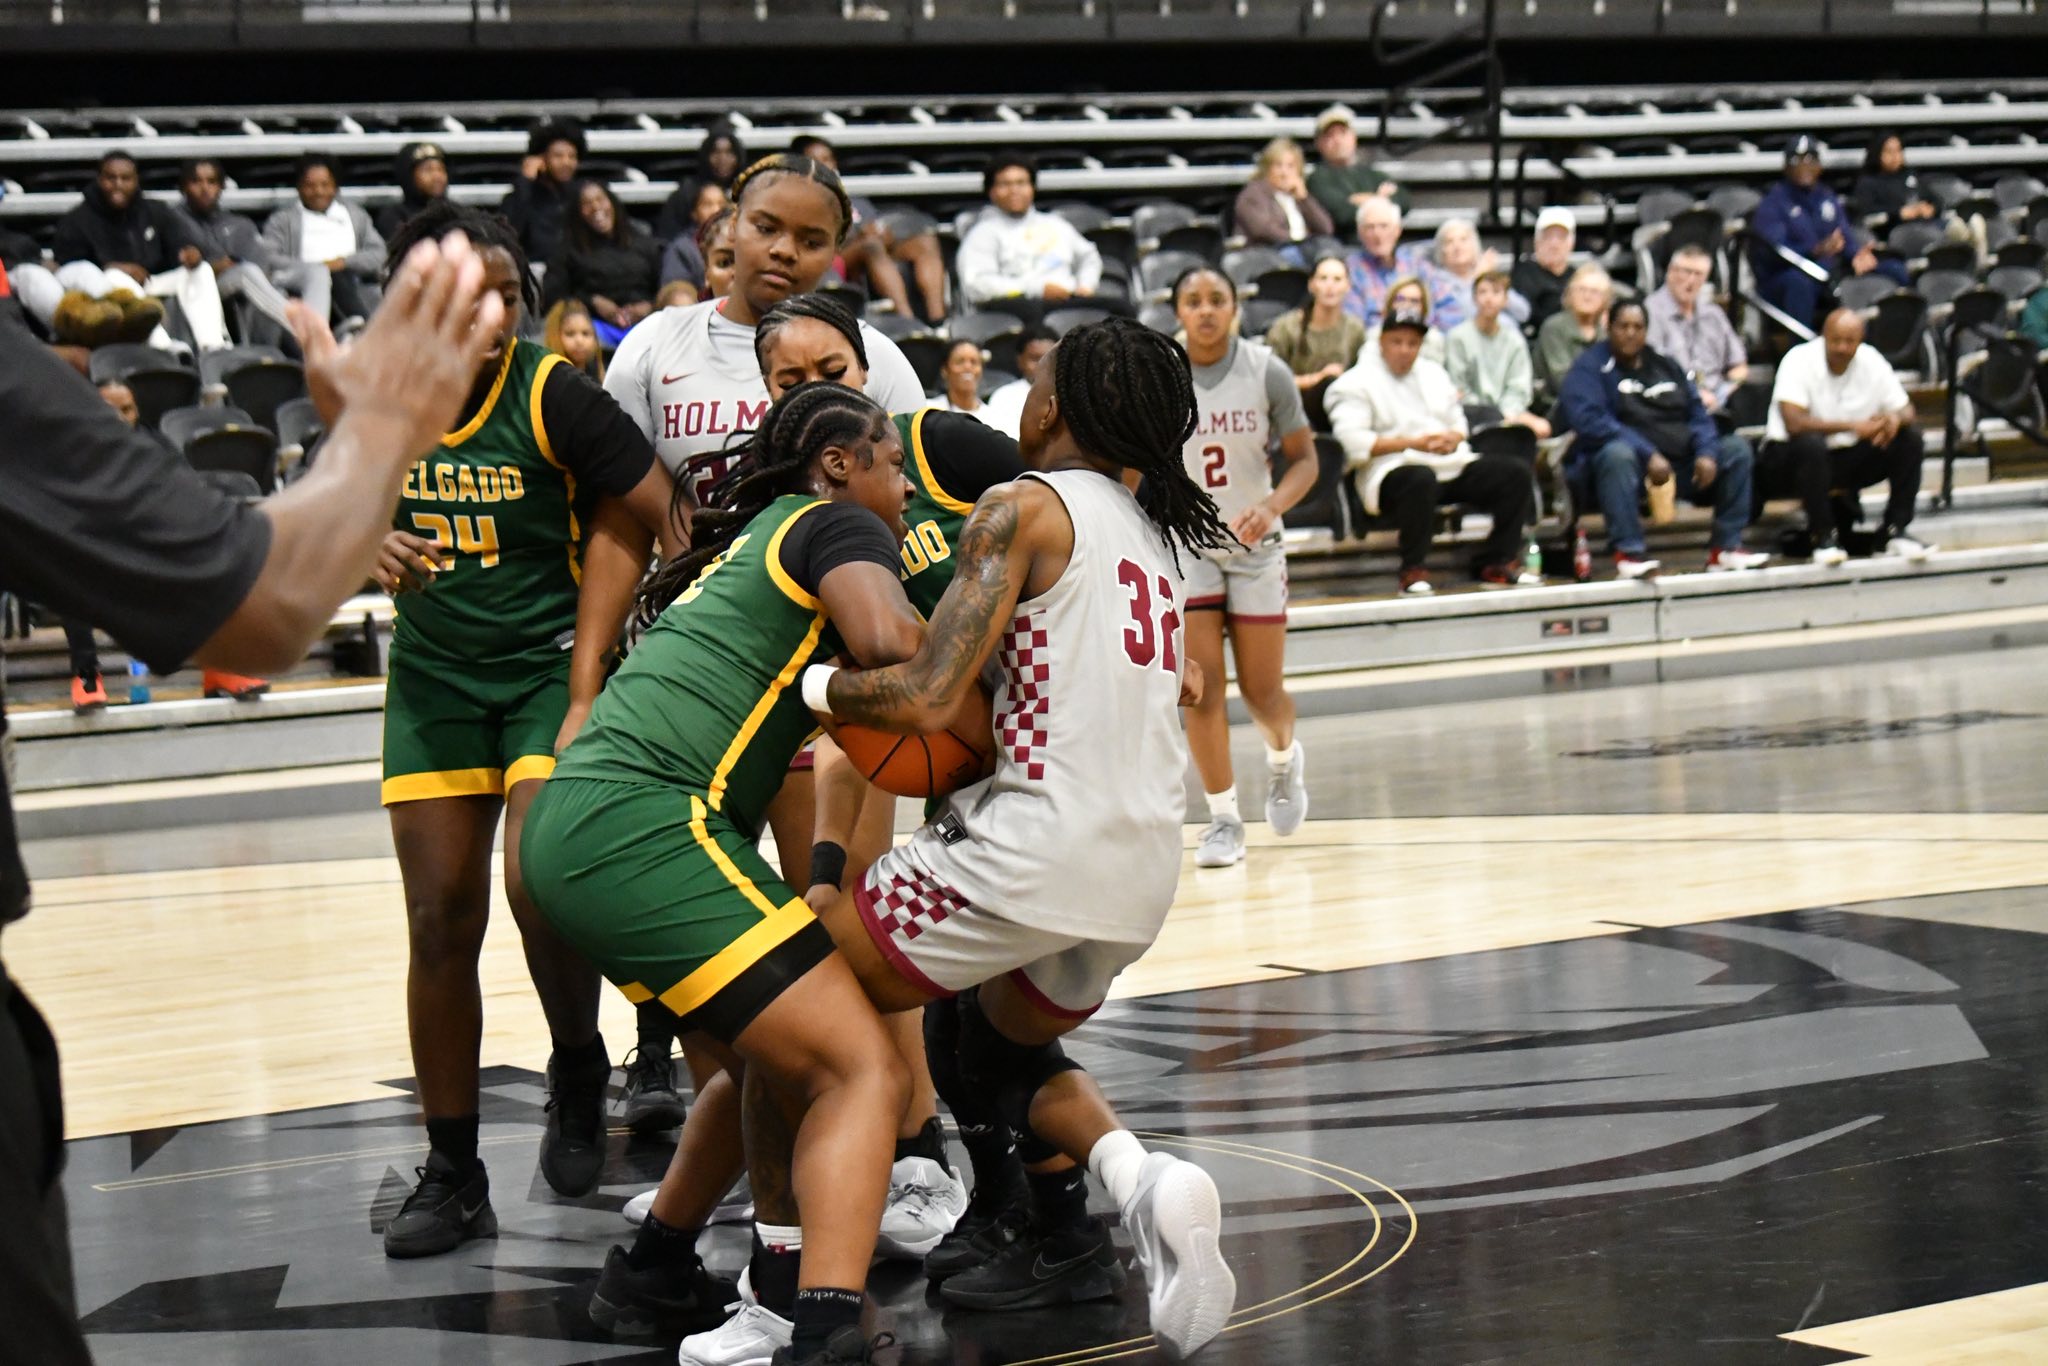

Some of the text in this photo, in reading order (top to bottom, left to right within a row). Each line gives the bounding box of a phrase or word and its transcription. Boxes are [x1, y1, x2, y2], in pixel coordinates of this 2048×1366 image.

[1202, 445, 1228, 488] 2
[411, 511, 500, 572] 24
[1116, 556, 1181, 674] 32
